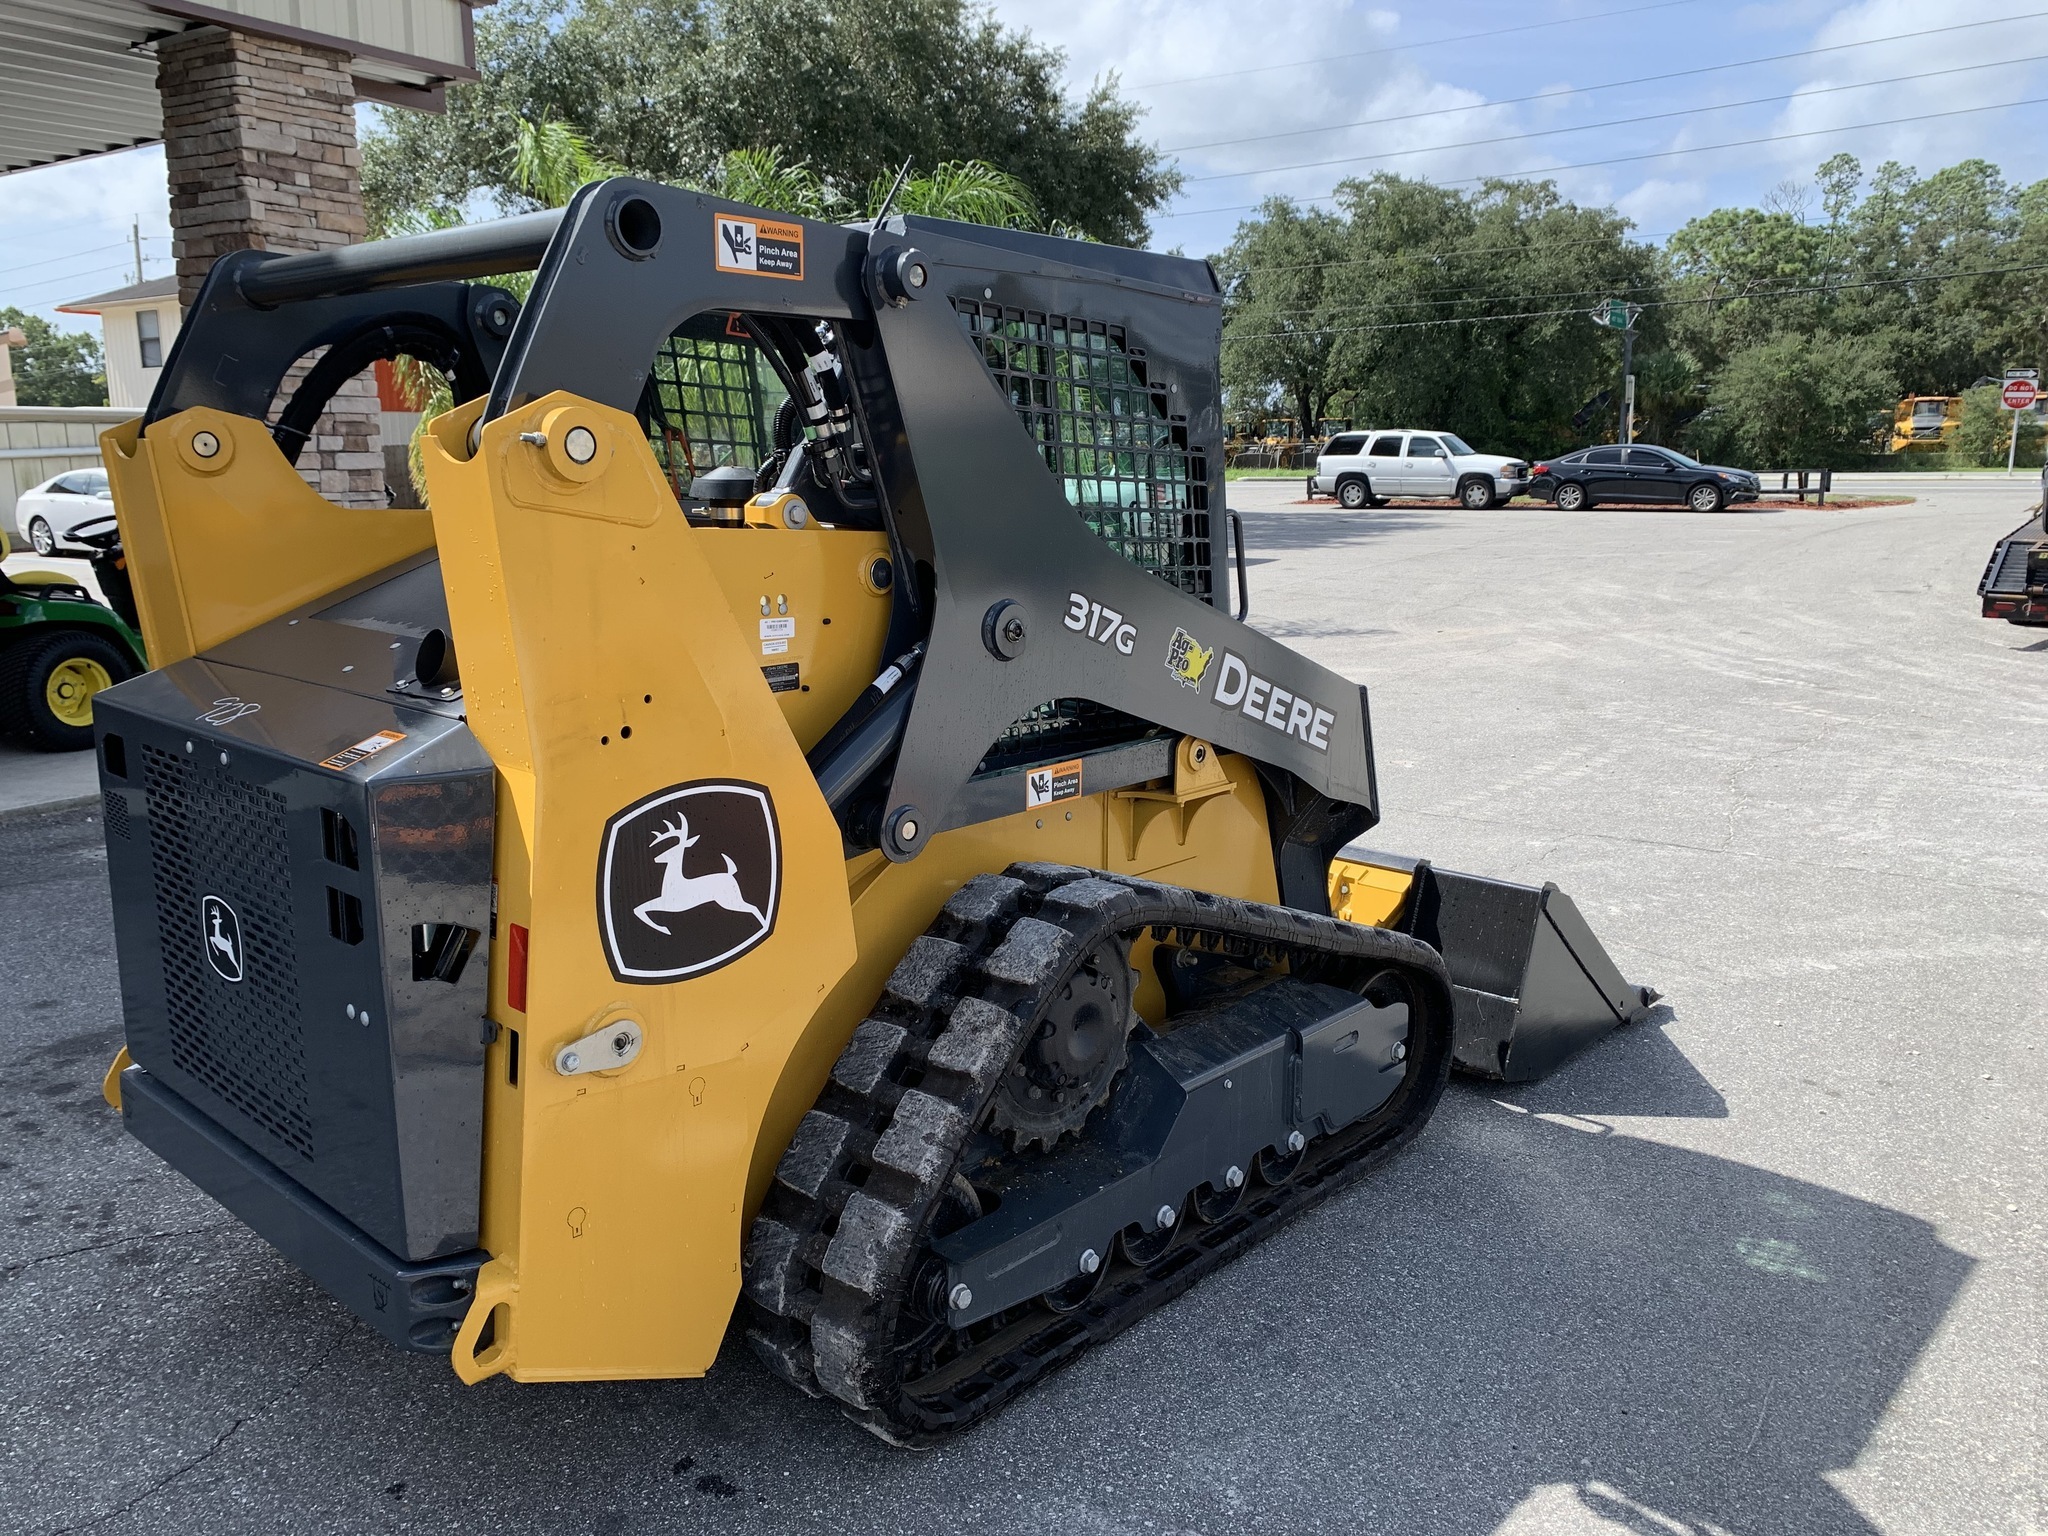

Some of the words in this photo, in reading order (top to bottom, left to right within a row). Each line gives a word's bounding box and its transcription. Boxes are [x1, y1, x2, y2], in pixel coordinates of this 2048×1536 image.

[766, 226, 799, 239] WARNING
[759, 245, 780, 256] Pinch
[781, 248, 798, 258] Area
[759, 257, 775, 267] Keep
[776, 260, 793, 270] Away
[1063, 592, 1137, 655] 317G
[1172, 631, 1194, 656] Ag-
[1167, 647, 1189, 671] Pro
[1214, 652, 1335, 751] DEERE
[1054, 780, 1067, 788] Pinch
